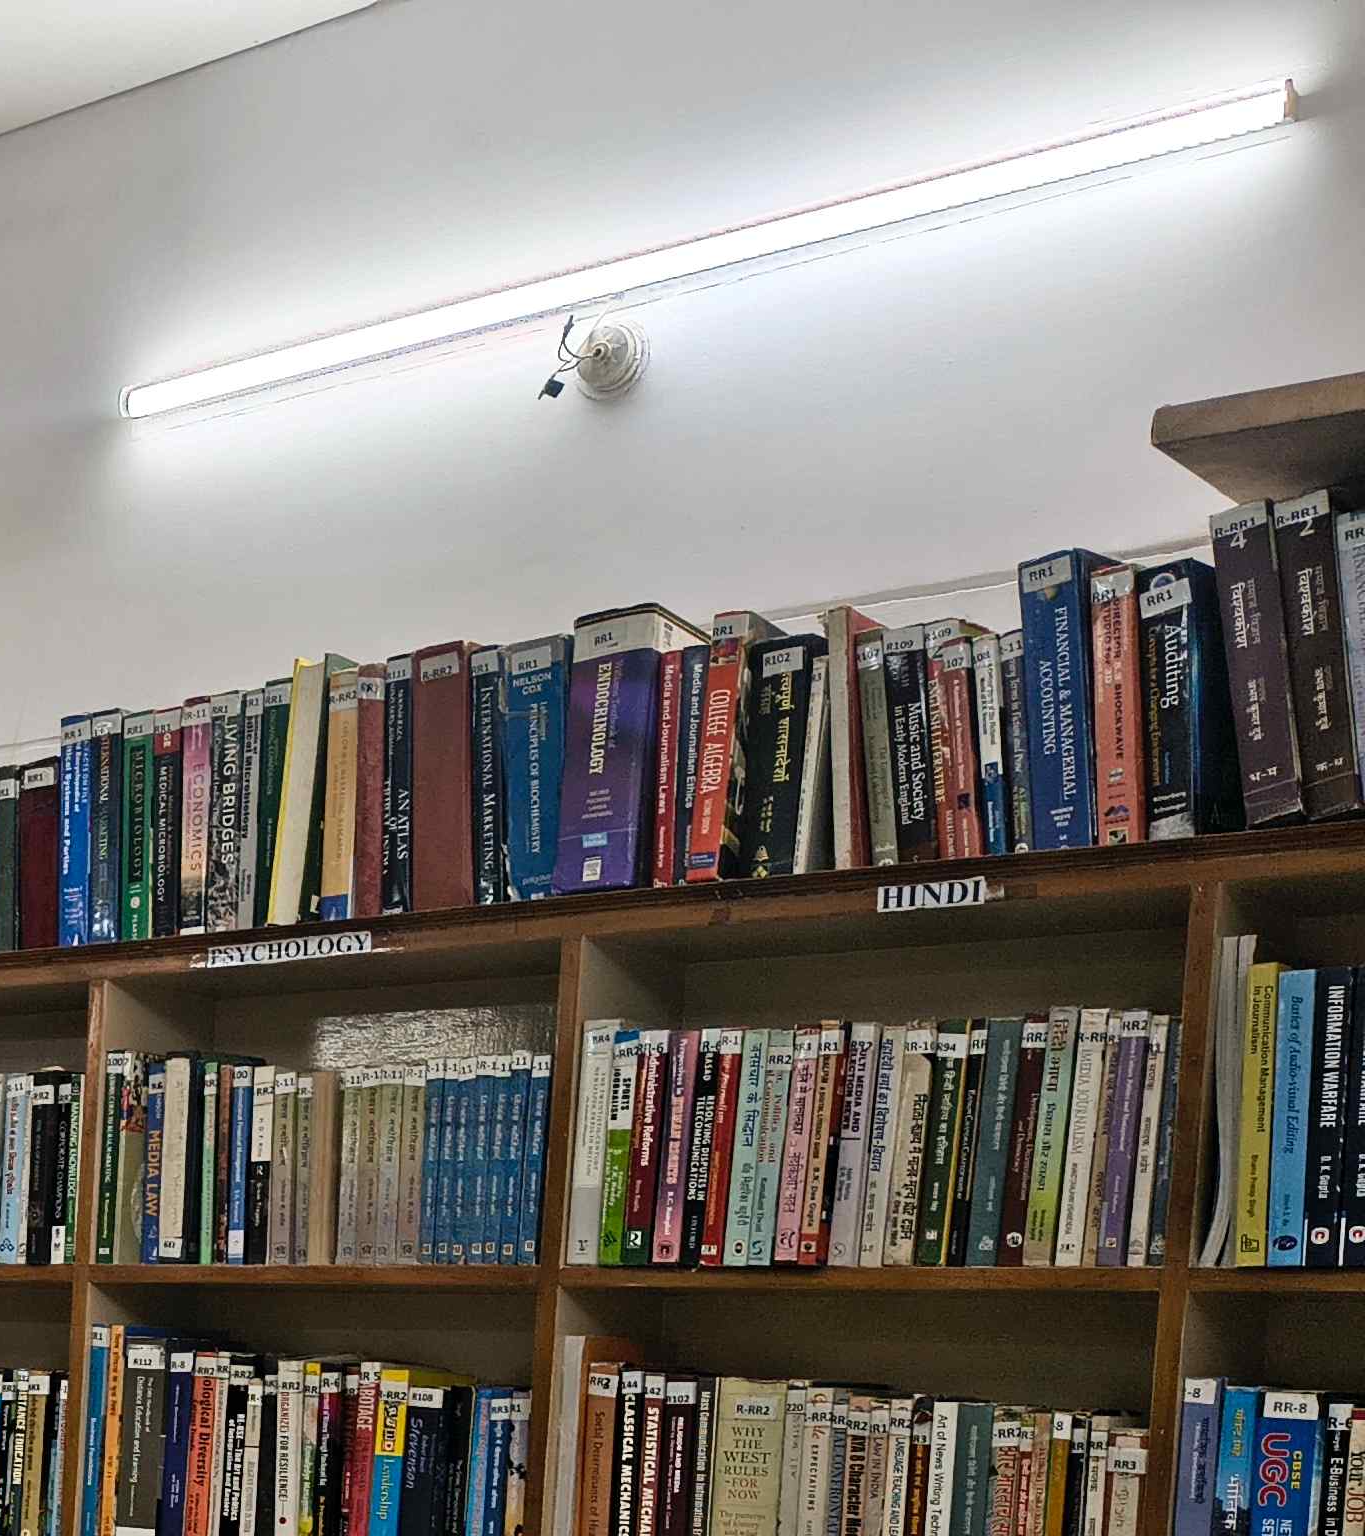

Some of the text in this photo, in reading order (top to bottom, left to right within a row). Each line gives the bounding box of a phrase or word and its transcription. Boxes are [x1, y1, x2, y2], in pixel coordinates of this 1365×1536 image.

[1277, 504, 1319, 526] R-RR1
[1299, 521, 1315, 537] 2
[1028, 566, 1054, 582] RR1
[1093, 588, 1117, 602] RR1
[1146, 589, 1173, 606] RR1
[594, 632, 613, 646] RR1
[713, 625, 733, 636] RR1
[512, 672, 552, 687] NELSON
[518, 660, 538, 671] RR1
[1160, 623, 1184, 710] Auditing
[522, 684, 542, 696] COX
[1038, 660, 1057, 755] ACCOUNTING
[1055, 606, 1077, 800] FINANCIAL MANAGERIAL
[588, 662, 612, 774] ENDOCRINOLOGY
[658, 665, 674, 784] Media and Journalism
[684, 663, 704, 809] Media and Journalism Ethics
[699, 689, 731, 794] COLLEGE ALGEBRA
[1114, 683, 1126, 759] SHOCKWAVE
[480, 687, 497, 870] INTERNATIONAL MARKETING
[894, 717, 912, 825] Early Modern England
[908, 702, 928, 821] Music and Society
[932, 730, 946, 803] LITERATURE
[131, 750, 146, 878] MICROBIOLOGY
[190, 763, 206, 872] ECONOMICS
[220, 783, 237, 864] BRIDGES
[530, 762, 541, 853] OF BIOCHEMISTRY
[156, 766, 168, 902] MEDICAL MICROBIOLOGY
[396, 814, 410, 859] ATLAS
[882, 879, 983, 910] HINDI
[209, 934, 369, 966] PSYCHOLOGY
[1250, 994, 1262, 1054] Journalism
[1256, 986, 1273, 1133] Communication Management
[1284, 996, 1303, 1154] Basics of Editing
[1319, 985, 1345, 1128] INFORMATION WARFARE
[620, 1077, 632, 1111] SPORTS
[851, 1075, 865, 1133] MEDIA AND
[640, 1125, 654, 1167] Reforms
[697, 1147, 710, 1188] DISPUTES
[145, 1130, 161, 1216] MEDIA LAW
[621, 1394, 636, 1460] CLASSICAL
[732, 1426, 766, 1438] WHY
[736, 1405, 770, 1415] R-RR2
[937, 1414, 948, 1428] Art
[1274, 1402, 1307, 1414] RR-8
[12, 1433, 26, 1484] EDUCATION
[194, 1432, 209, 1487] Diversity
[279, 1436, 289, 1451] FOR
[405, 1417, 425, 1489] Stevenson
[642, 1407, 660, 1484] STATISTICAL
[723, 1451, 771, 1464] WEST
[733, 1440, 763, 1449] THE
[893, 1437, 907, 1473] LANGUAGE
[934, 1443, 946, 1470] News
[936, 1431, 946, 1440] of
[724, 1466, 769, 1477] RULES
[807, 1444, 819, 1511] EXPECTATIONS
[870, 1437, 885, 1499] LAW INDIA
[1114, 1459, 1136, 1469] RR3
[1257, 1433, 1291, 1507] UGC
[1291, 1450, 1302, 1489] CBSE
[1326, 1457, 1343, 1512] E-Business
[379, 1459, 395, 1520] Leadership
[727, 1488, 761, 1499] NOW
[847, 1463, 865, 1516] Character
[890, 1475, 903, 1508] TEACHING
[930, 1473, 943, 1505] Writing
[889, 1509, 901, 1524] AND
[1326, 1517, 1338, 1527] in
